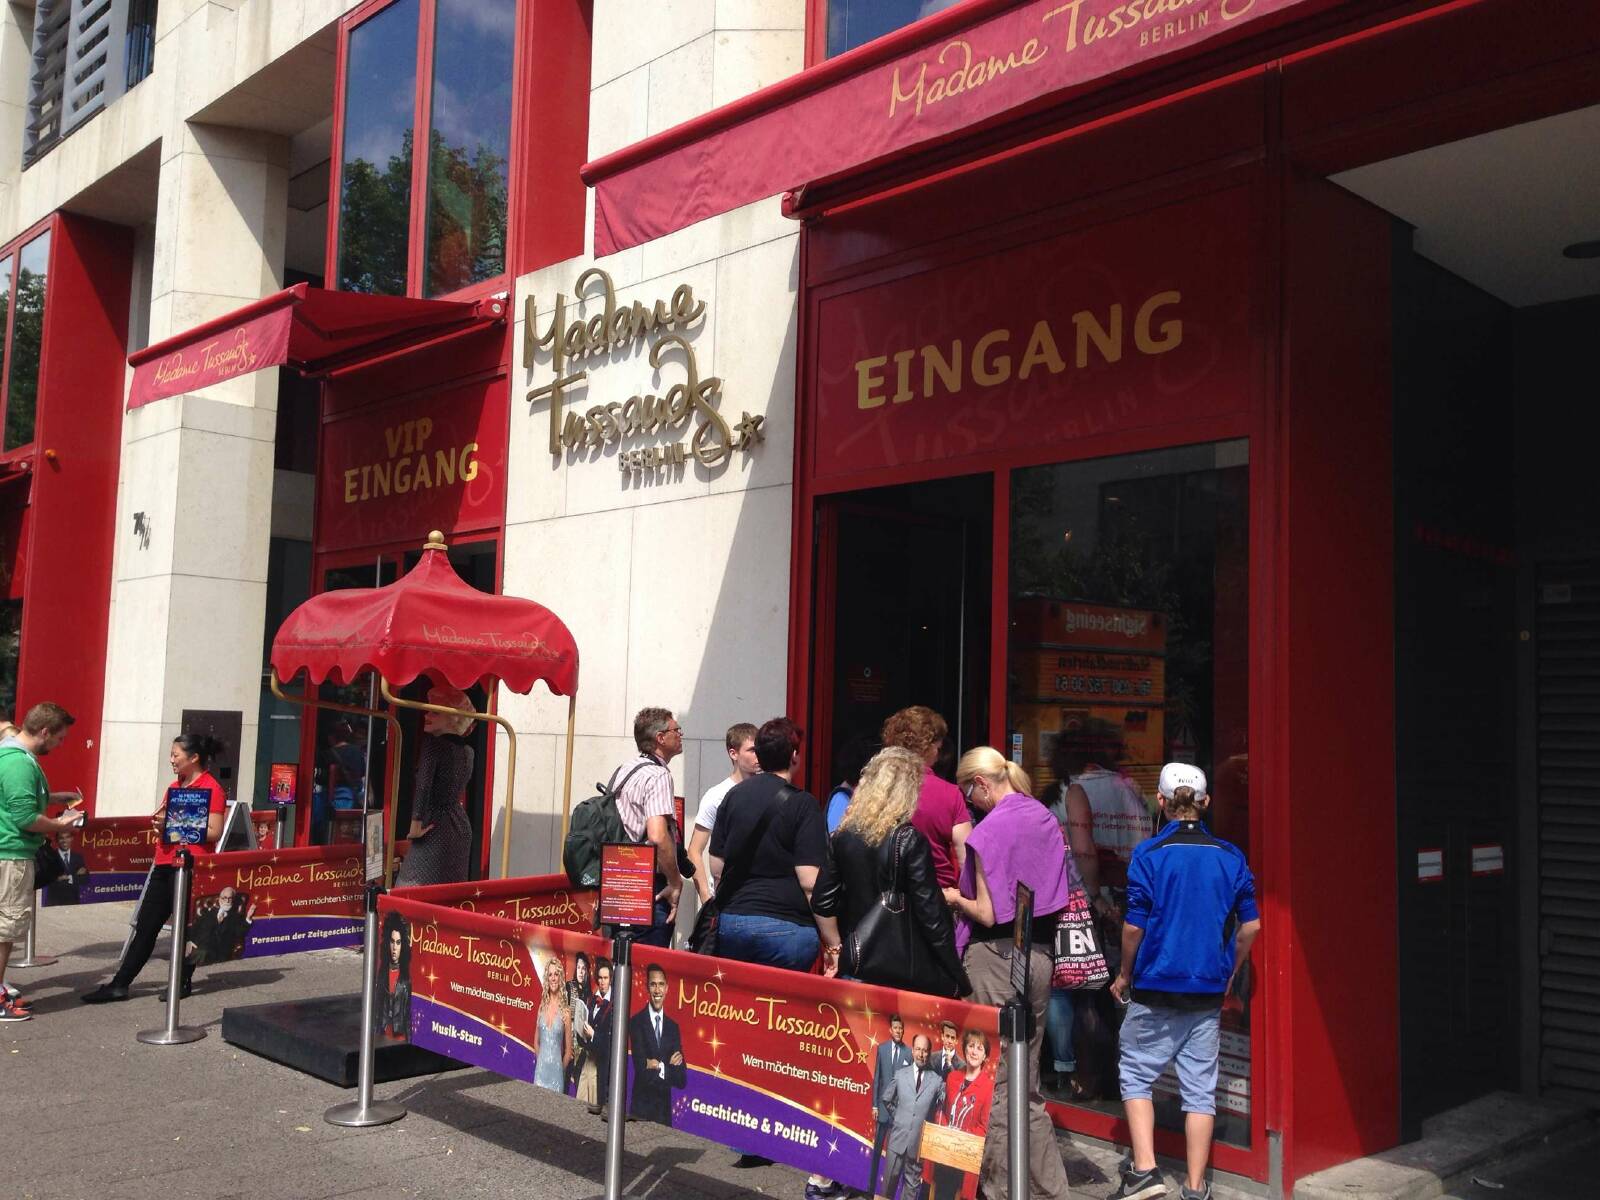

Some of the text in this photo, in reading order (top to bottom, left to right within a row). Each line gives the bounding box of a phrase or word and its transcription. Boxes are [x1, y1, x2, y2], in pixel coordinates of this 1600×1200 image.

[1140, 10, 1209, 47] BERLIN
[889, 40, 1048, 119] Madame
[523, 267, 705, 373] Madame
[152, 328, 249, 386] Madame Tussauds
[855, 290, 1183, 410] EINGANG
[526, 335, 731, 464] Tussauds
[384, 417, 433, 459] VIP
[344, 443, 478, 504] EINGANG
[619, 443, 685, 472] BERLIN
[422, 624, 486, 645] Madame
[81, 829, 142, 849] Madame
[94, 882, 144, 893] Geschichte
[236, 865, 304, 890] Madame
[290, 899, 308, 907] Wen
[308, 895, 342, 905] möchten
[342, 894, 353, 902] Sie
[505, 890, 580, 925] Tussauds
[252, 925, 365, 945] Personen der Zeitgeschichte
[541, 918, 565, 927] BERLIN
[408, 924, 522, 987] Madame Tussauds
[487, 970, 510, 983] BERLIN
[450, 981, 534, 1011] Wen möchten Sie treffen?
[432, 1021, 483, 1045] Musik-Stars
[677, 978, 853, 1064] Madame Tussauds
[799, 1042, 833, 1058] BERLIN
[742, 1053, 871, 1095] Wen möchten Sie treffen?
[691, 1098, 819, 1148] Geschichte & Politik
